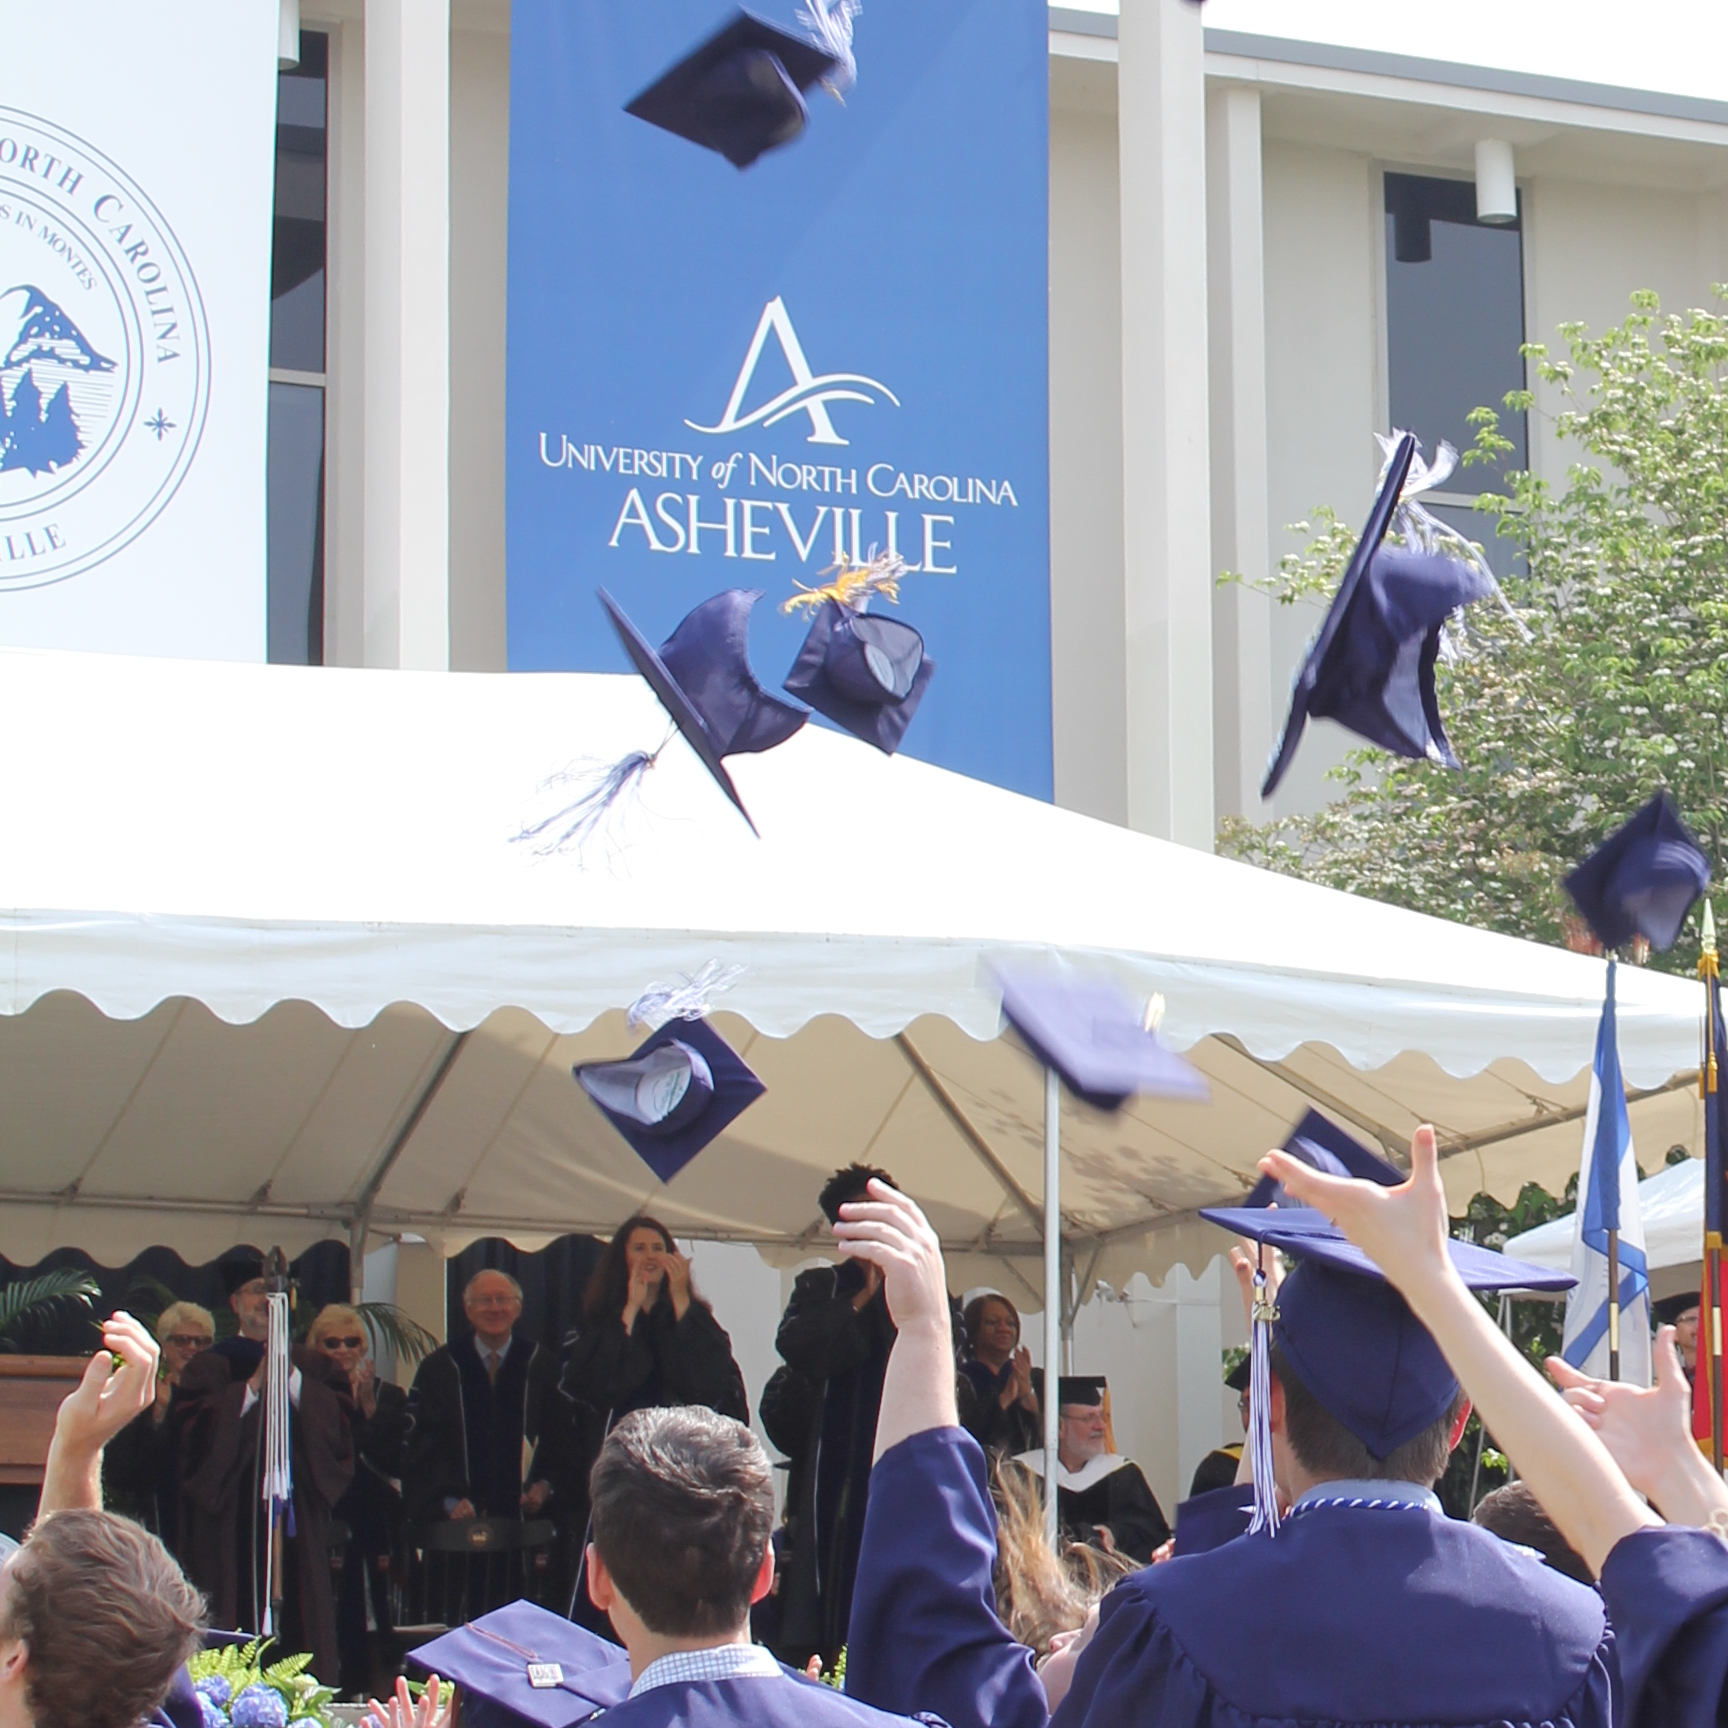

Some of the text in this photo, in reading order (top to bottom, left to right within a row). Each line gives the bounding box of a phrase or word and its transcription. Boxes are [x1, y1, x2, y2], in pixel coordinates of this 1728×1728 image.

[15, 211, 38, 231] IN
[37, 225, 98, 290] MONTES
[94, 194, 181, 364] CAROLINA
[539, 432, 1018, 507] UNIVERSITY of NORTH CAROLINA
[0, 523, 66, 562] LLE
[608, 487, 957, 574] ASHEVILLE
